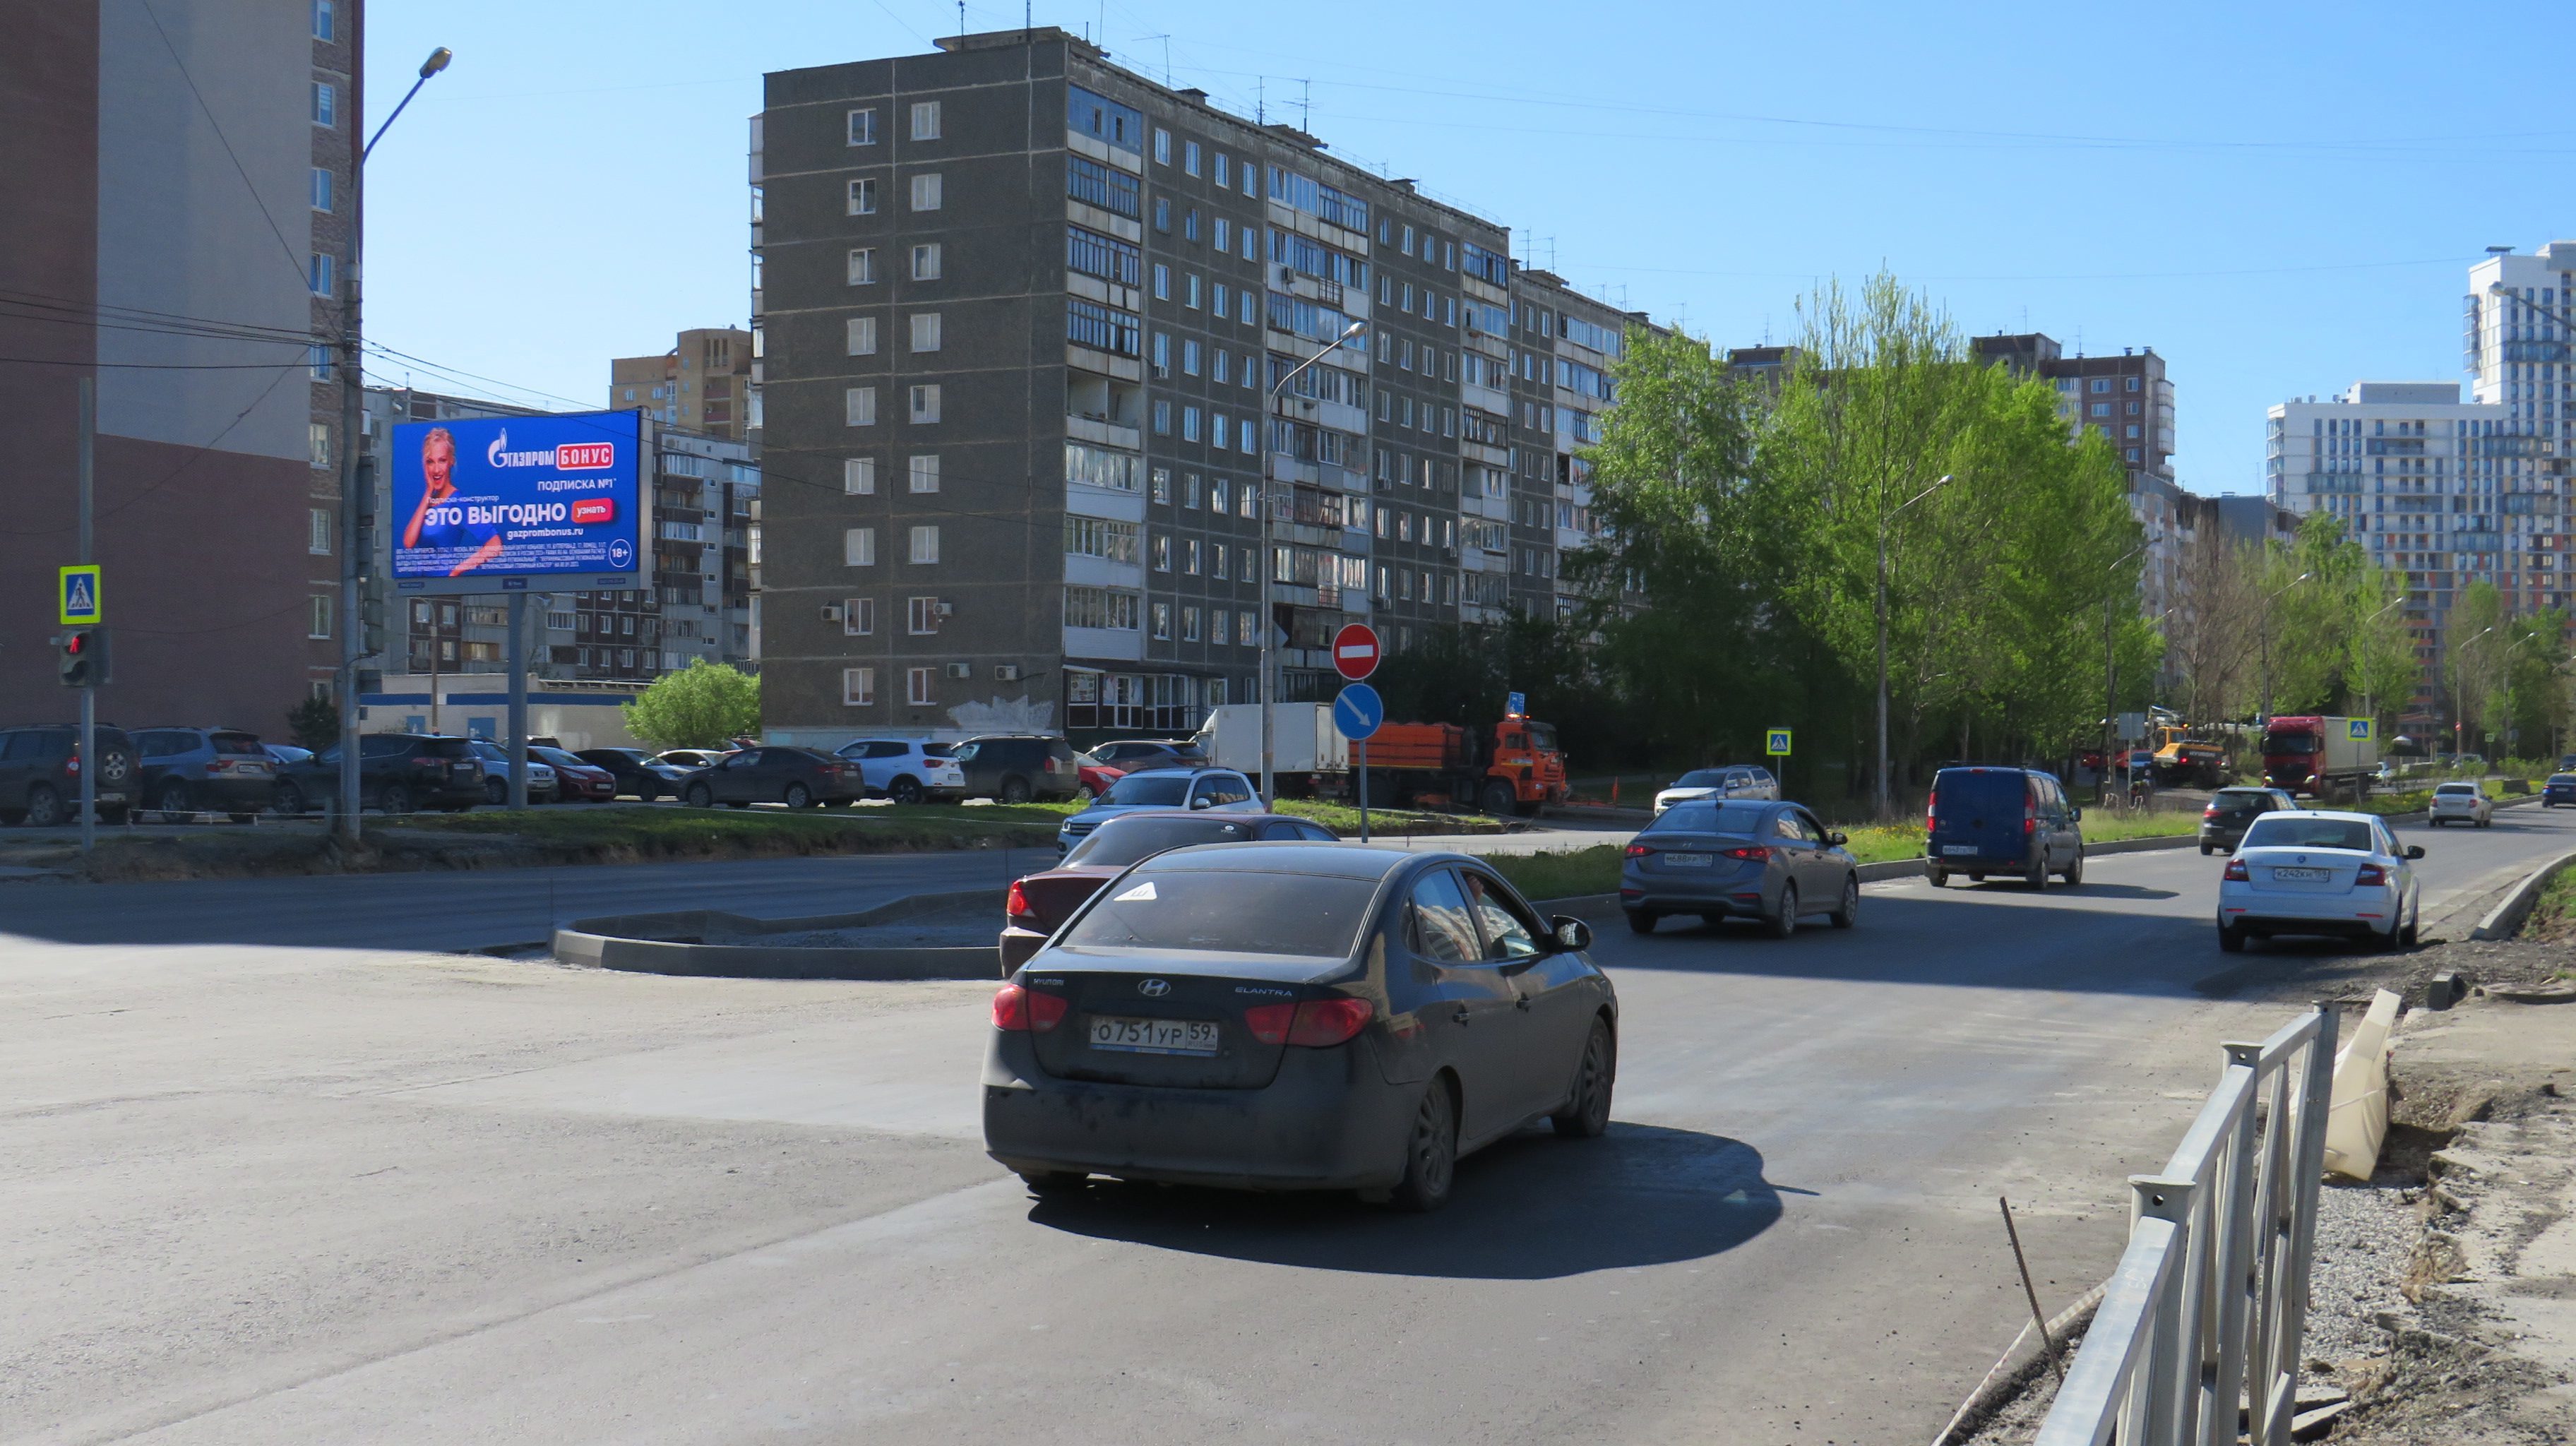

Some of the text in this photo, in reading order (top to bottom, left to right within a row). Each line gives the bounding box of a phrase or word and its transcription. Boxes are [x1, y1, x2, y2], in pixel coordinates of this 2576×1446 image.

[508, 447, 610, 467] ГАЗПРОМ БОНУС
[537, 479, 596, 492] ПОДПИСКА
[425, 502, 566, 527] ЭТО ВЫГОДНО
[576, 505, 607, 518] узнать
[506, 527, 584, 540] gazprombonus.ru
[611, 547, 629, 558] 18+
[1033, 978, 1066, 986] HYUNDAI
[1234, 986, 1293, 997] ELANTRA
